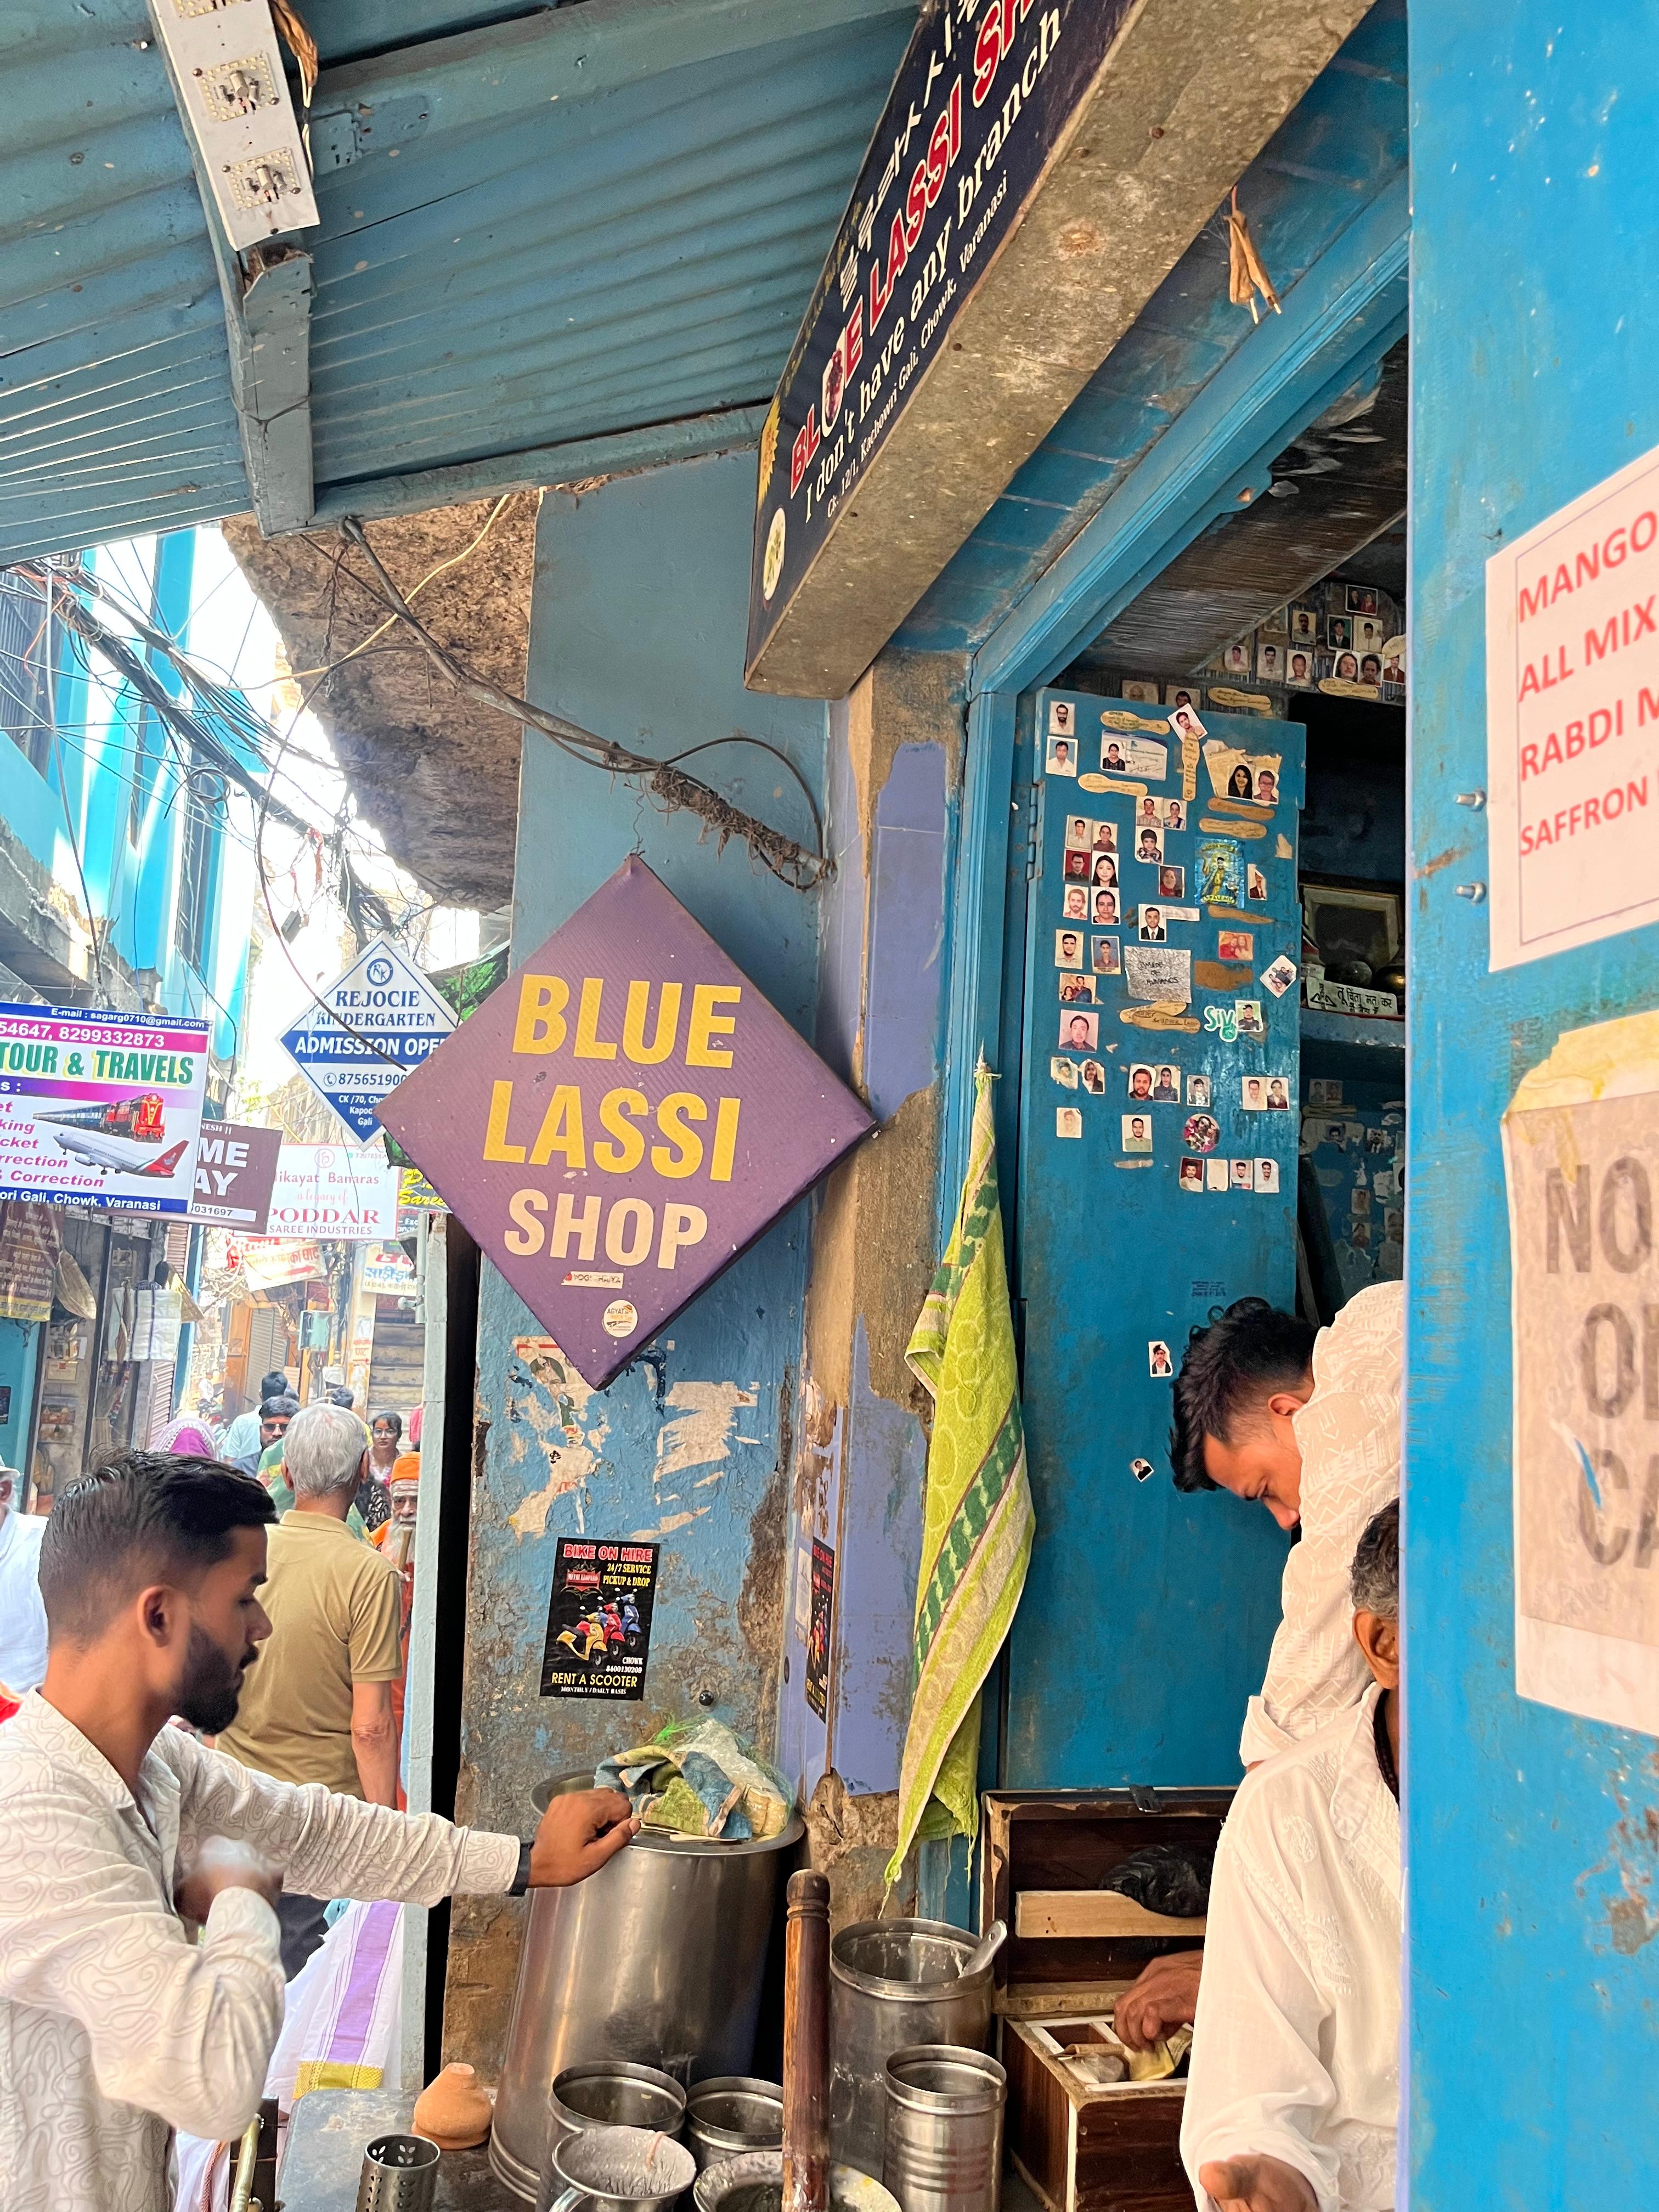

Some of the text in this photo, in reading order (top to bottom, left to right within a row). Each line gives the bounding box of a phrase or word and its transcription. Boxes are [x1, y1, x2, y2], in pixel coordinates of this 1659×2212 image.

[960, 170, 1007, 273] Varanasi
[805, 483, 812, 523] I
[816, 408, 855, 502] don't
[859, 317, 905, 424] have
[911, 216, 952, 322] any
[958, 8, 1061, 230] branch
[791, 295, 863, 499] BLUE
[870, 73, 962, 336] LASSI
[1519, 510, 1658, 623] MANGO
[1518, 594, 1657, 703] ALL MIX
[1521, 698, 1623, 782] RABDI
[1520, 775, 1647, 856] SAFFRON
[335, 990, 420, 1007] REJOCIE
[51, 1008, 82, 1018] E-mail
[90, 1013, 205, 1029] sagarg0710@gmail.com
[317, 1013, 436, 1026] KINDERGARTEN
[512, 973, 742, 1069] BLUE
[59, 1026, 165, 1047] 8299332873
[295, 1036, 445, 1056] ADMISSION OPE
[0, 1042, 194, 1085] TOUR & TRAVELS
[358, 1117, 373, 1126] Gali
[482, 1079, 741, 1182] LASSI
[10, 1170, 104, 1187] Correction
[328, 1172, 379, 1184] Banaras
[106, 1196, 161, 1211] Varanasi
[1545, 1155, 1653, 1274] NO
[269, 1225, 372, 1235] SAREE INDUSTRIES
[504, 1188, 708, 1271] SHOP
[563, 1543, 653, 1563] BIKE ON HIRE
[607, 1562, 652, 1575] 24/7 SERVICE
[602, 1575, 627, 1585] PICKUP
[632, 1577, 651, 1587] DROP
[551, 1672, 638, 1688] RENT A SCOOTER
